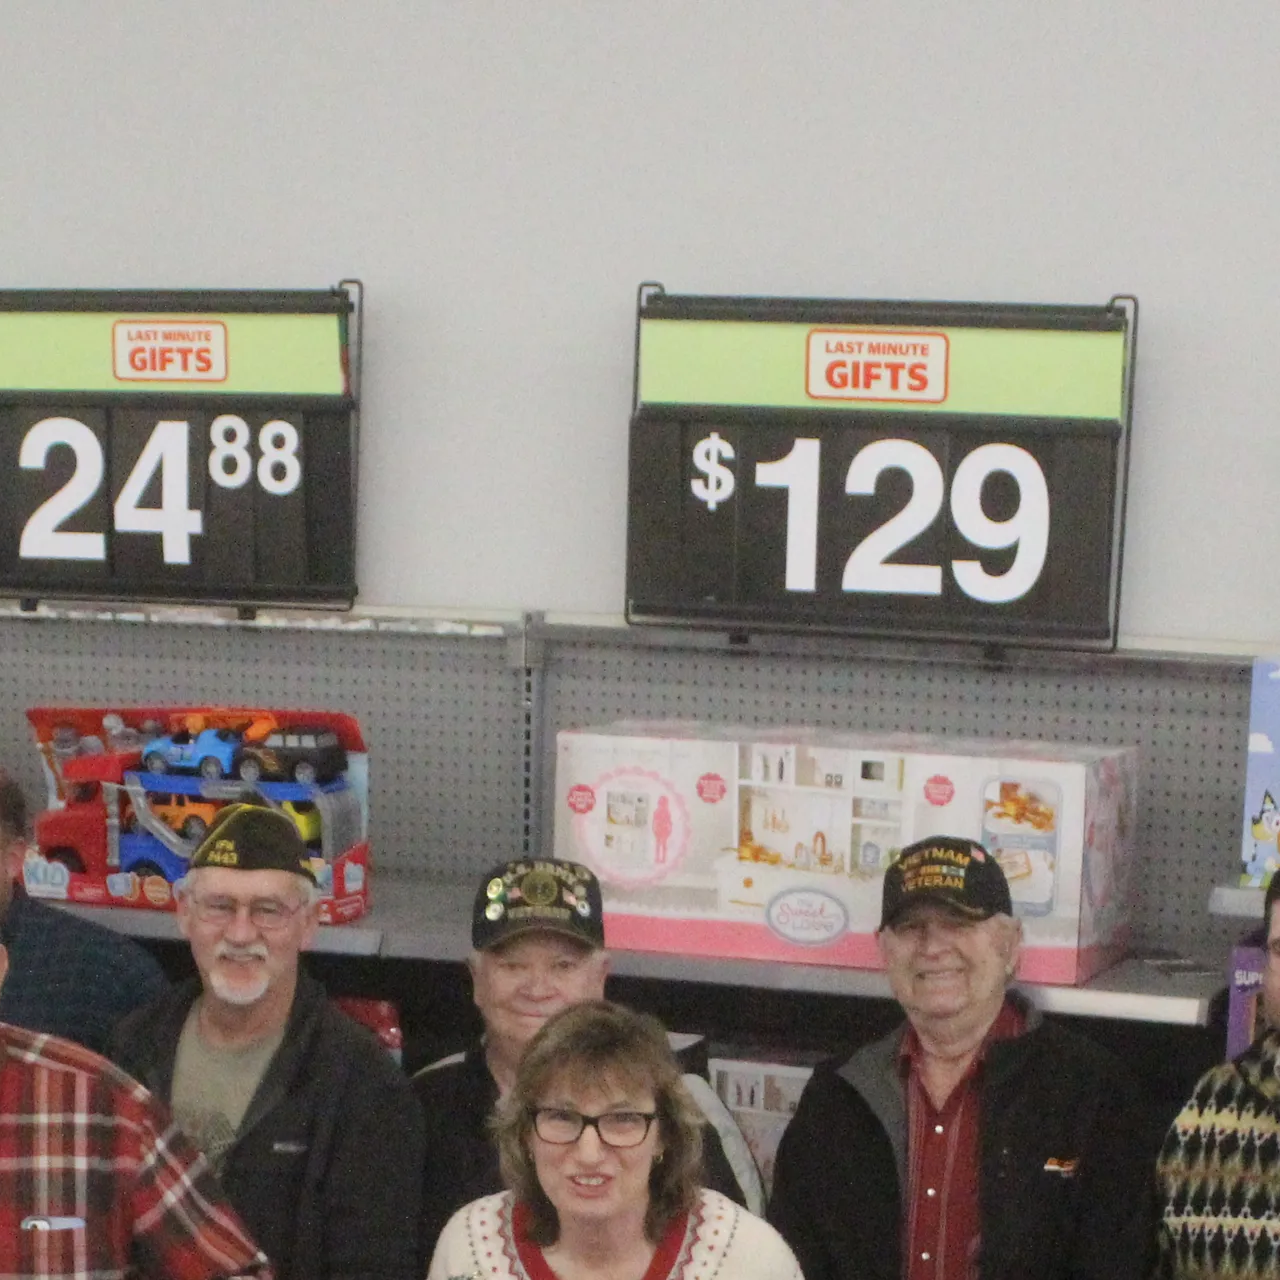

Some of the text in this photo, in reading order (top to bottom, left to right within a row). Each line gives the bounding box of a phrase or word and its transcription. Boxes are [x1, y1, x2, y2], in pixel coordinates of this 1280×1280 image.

[127, 329, 213, 343] LAST MINUTE
[824, 339, 930, 358] LAST MINUTE
[128, 346, 213, 374] GIFTS
[824, 359, 929, 393] GIFTS
[898, 846, 971, 871] VIETNAM
[901, 874, 965, 893] VETERAN
